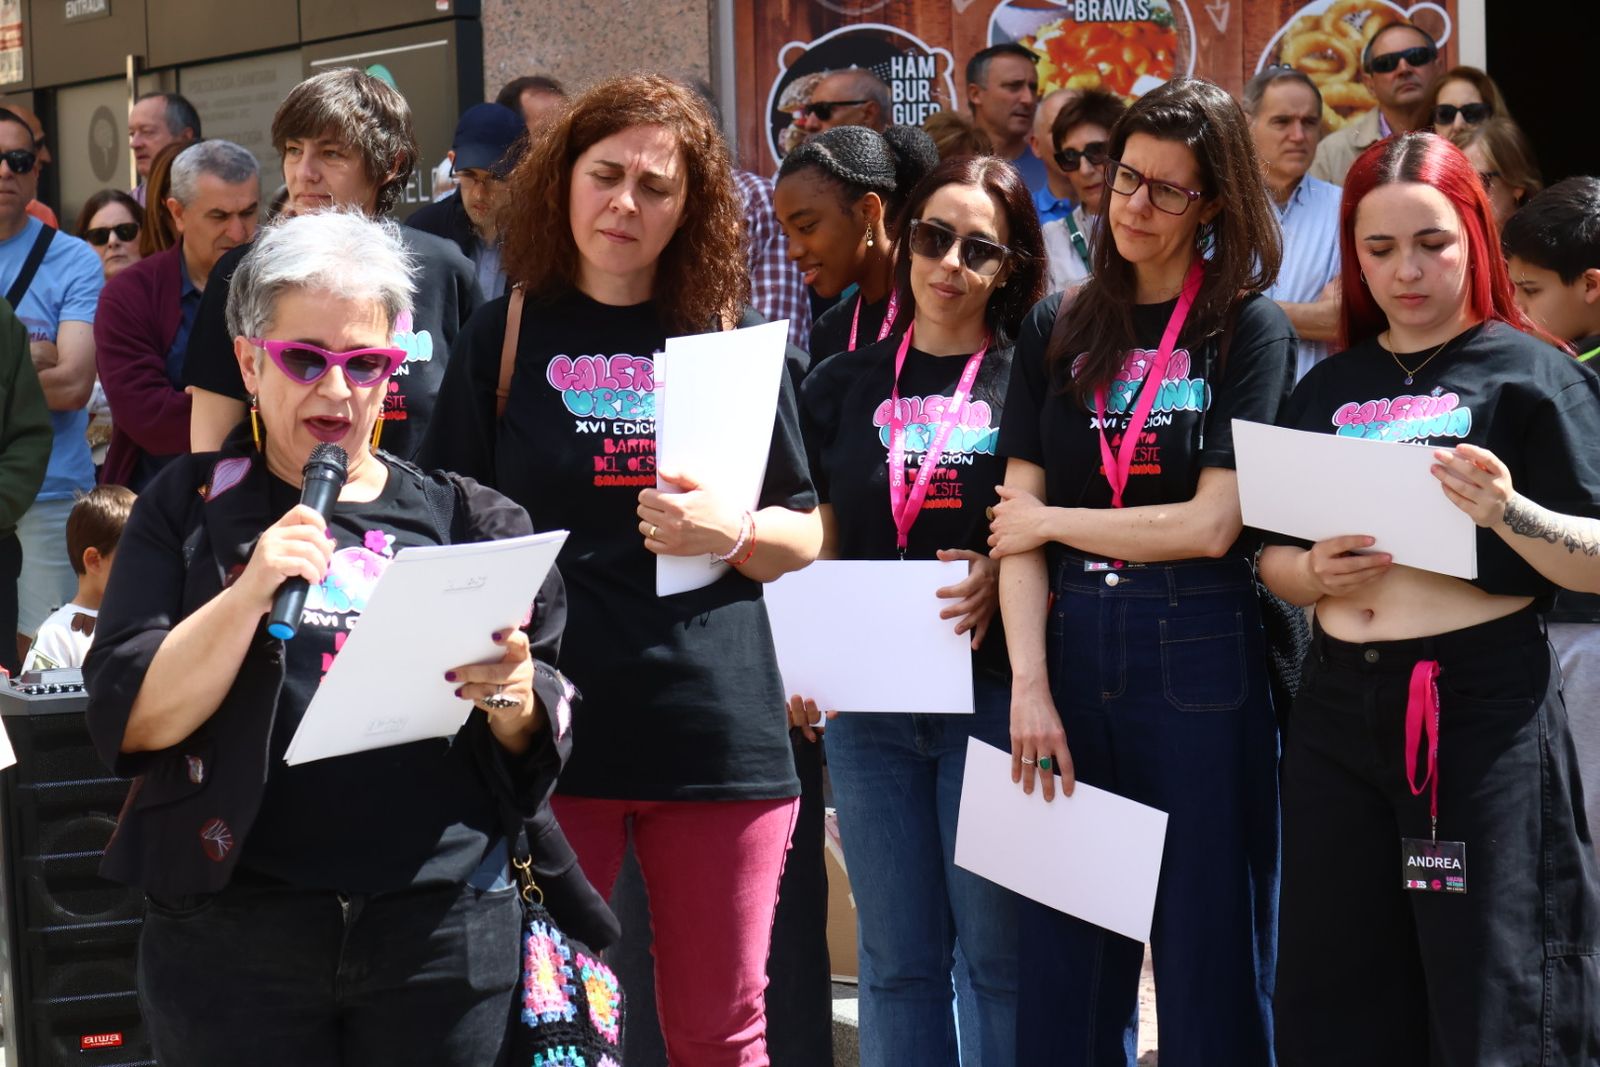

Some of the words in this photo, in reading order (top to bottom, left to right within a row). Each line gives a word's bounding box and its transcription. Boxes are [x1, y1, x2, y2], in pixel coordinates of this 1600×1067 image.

[1075, 0, 1149, 22] BRAVAS
[892, 79, 930, 103] BUR
[546, 353, 655, 392] GALER
[562, 387, 656, 420] URB
[575, 420, 606, 434] XVI
[612, 421, 656, 435] EDICI
[1089, 416, 1118, 430] XVI
[603, 438, 656, 454] BARRI
[1133, 446, 1161, 462] ESTE
[592, 455, 620, 472] DEL
[627, 455, 656, 472] OES
[917, 452, 974, 466] ECIÓN
[892, 469, 903, 487] Soy
[917, 461, 932, 486] oeste
[303, 609, 338, 627] XVI
[1407, 856, 1461, 869] ANDREA
[83, 1033, 119, 1044] aiwa
